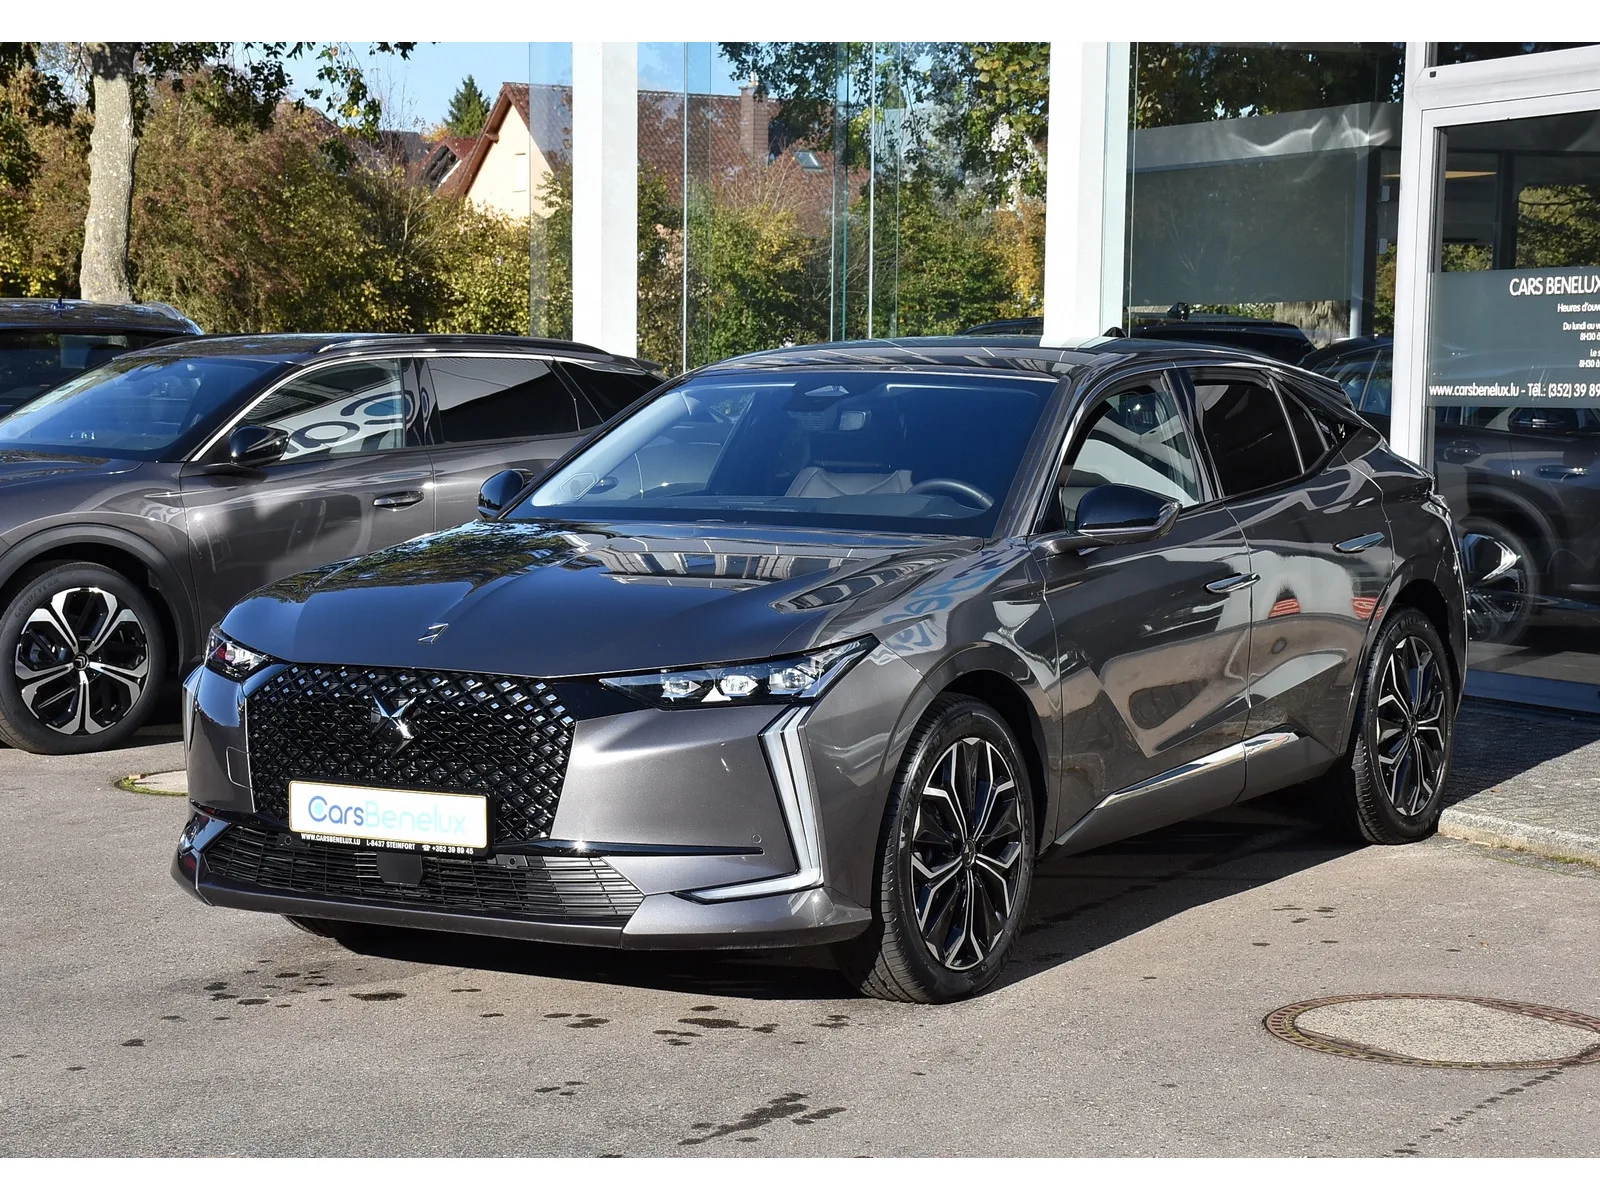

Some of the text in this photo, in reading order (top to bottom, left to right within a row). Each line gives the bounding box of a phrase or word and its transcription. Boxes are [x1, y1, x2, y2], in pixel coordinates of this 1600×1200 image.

[1509, 275, 1600, 296] CARS BENELUX
[1557, 301, 1600, 312] Heures d'ouv
[1562, 321, 1571, 331] Du
[1572, 321, 1587, 330] lundi
[1580, 332, 1596, 341] 8H30
[1590, 348, 1597, 357] Le
[1578, 359, 1595, 368] 8H30
[1428, 382, 1519, 397] www.carsbenelux.lu
[1548, 383, 1572, 398] (352)
[1573, 383, 1587, 397] 39
[1588, 383, 1600, 397] 89
[307, 795, 467, 835] CarsBenelux
[300, 832, 361, 846] WWW.CARSBENELUX.LU
[385, 841, 416, 850] STEINFORT
